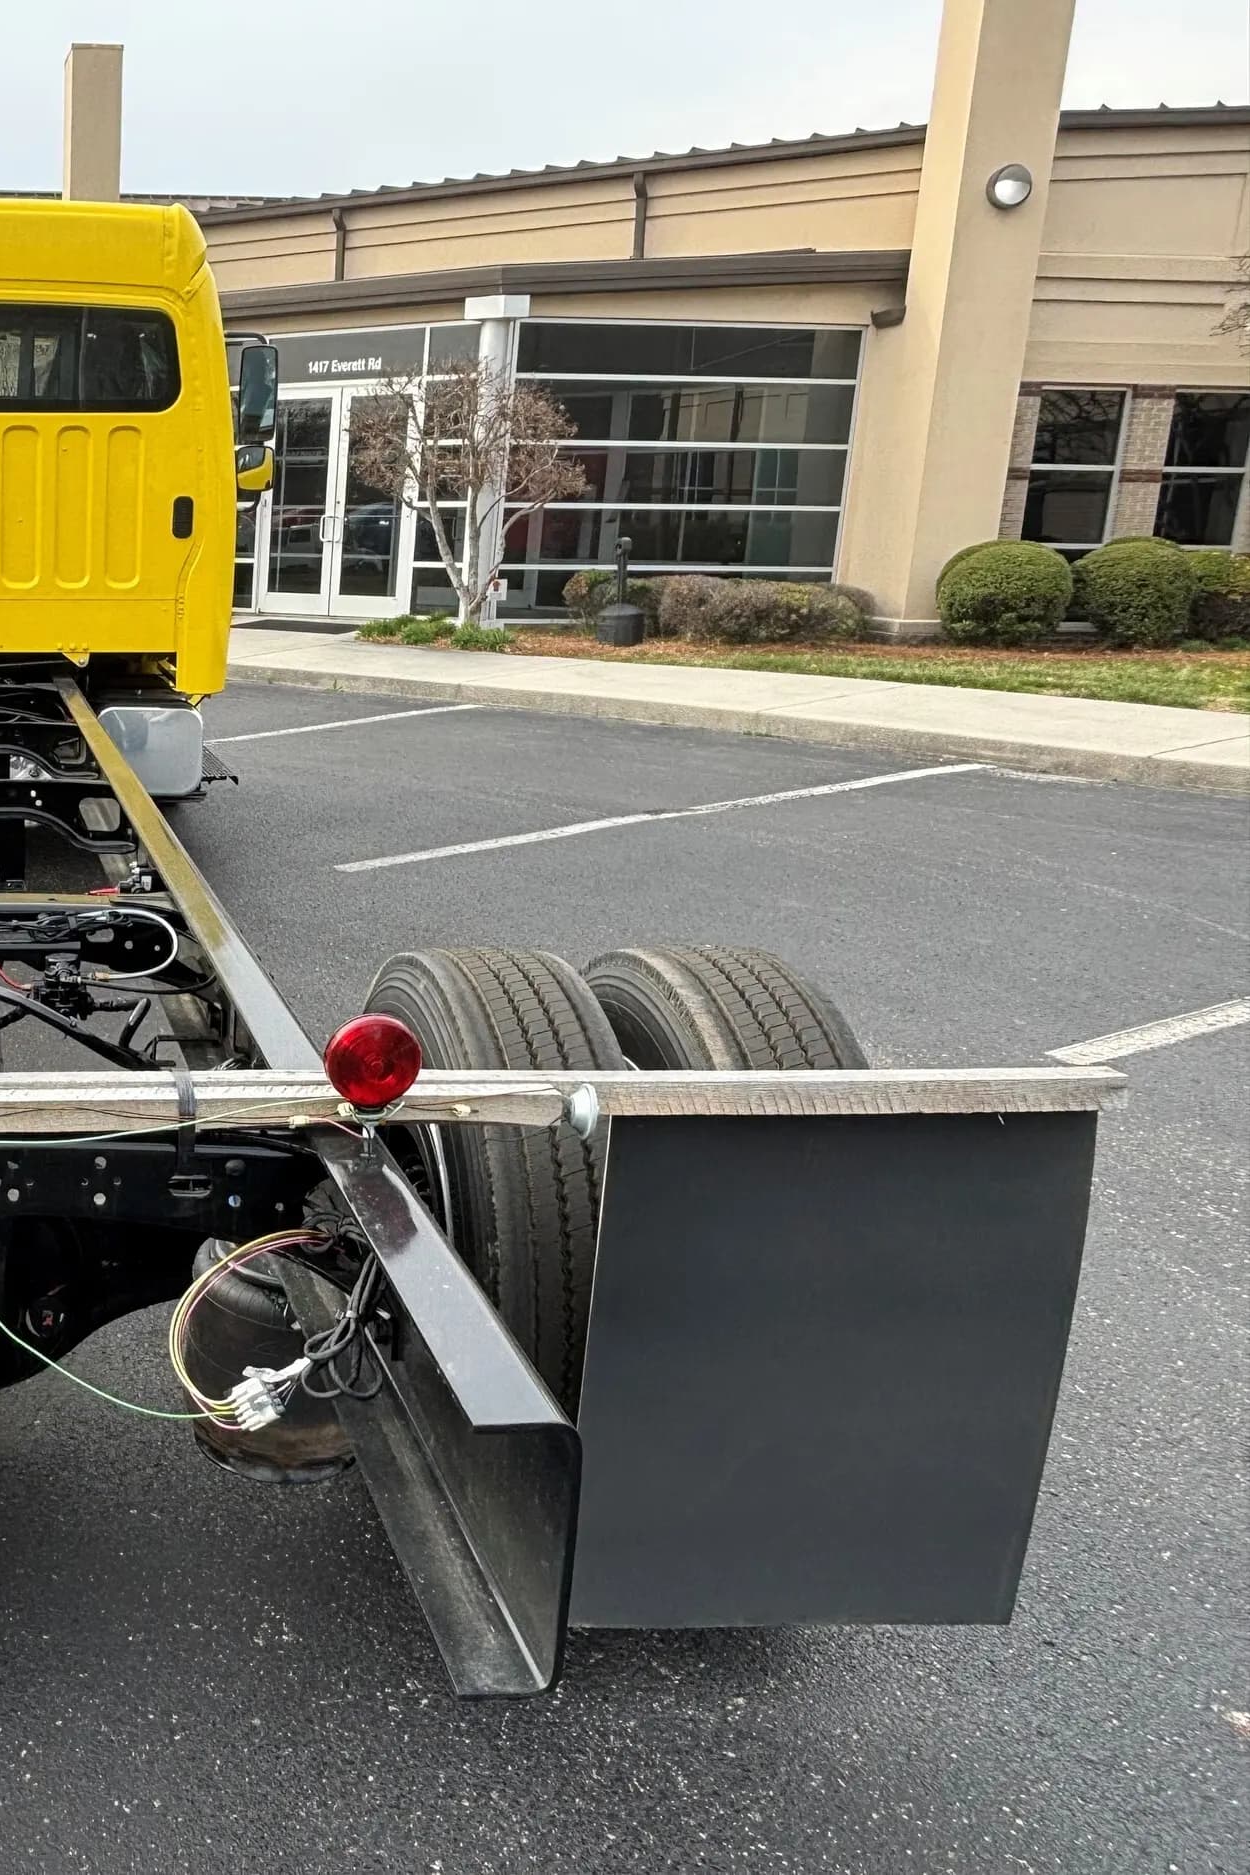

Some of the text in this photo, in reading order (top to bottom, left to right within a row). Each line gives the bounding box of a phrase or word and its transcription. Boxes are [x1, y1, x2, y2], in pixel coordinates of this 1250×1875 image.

[308, 356, 382, 374] 1417 Everett Rd
